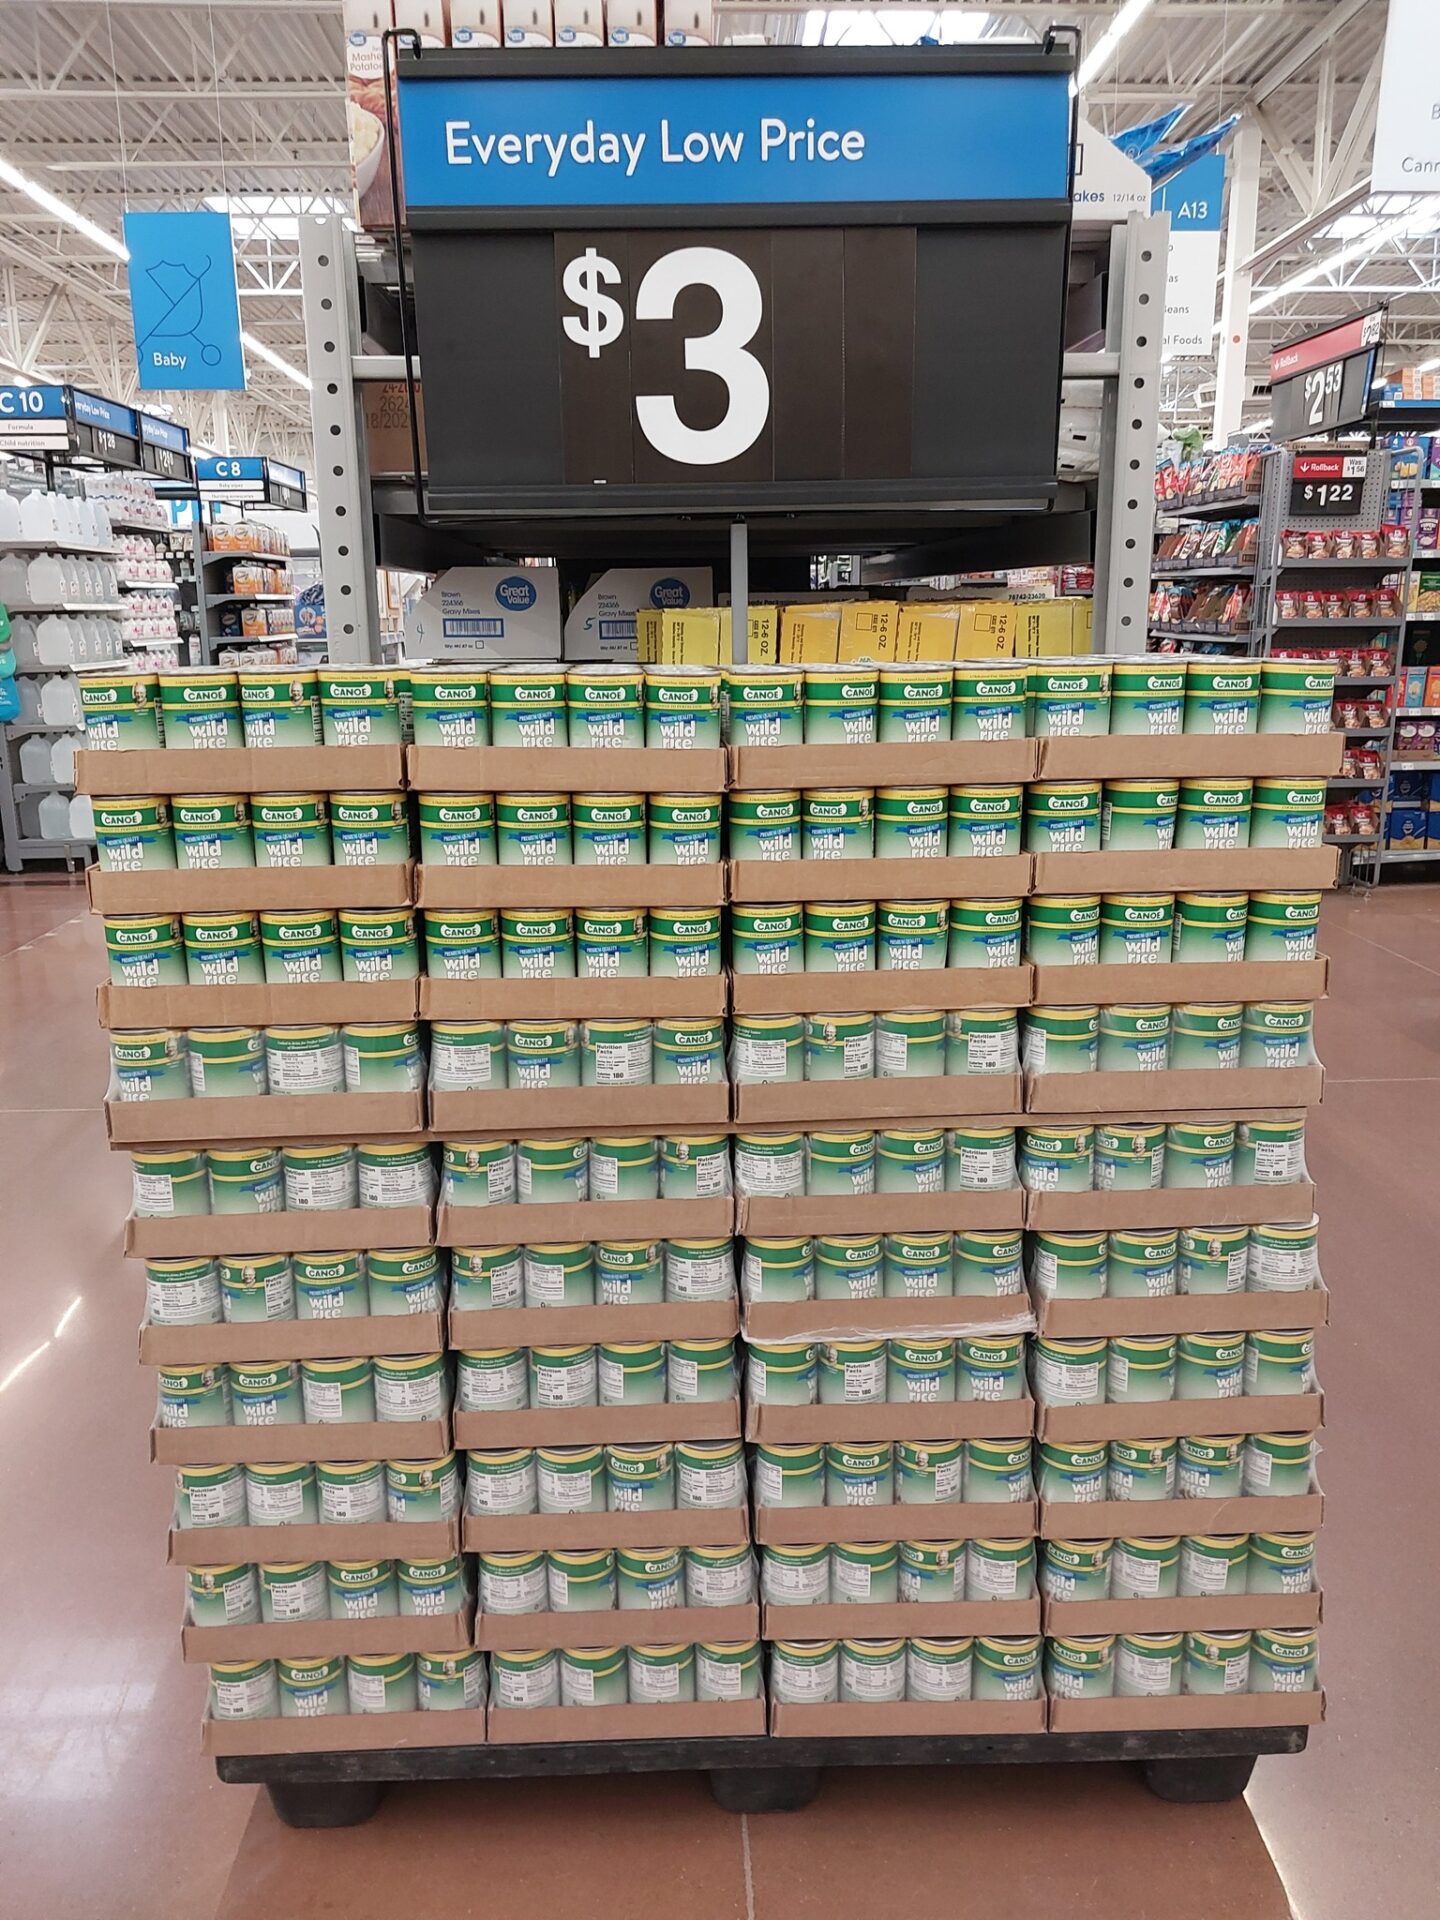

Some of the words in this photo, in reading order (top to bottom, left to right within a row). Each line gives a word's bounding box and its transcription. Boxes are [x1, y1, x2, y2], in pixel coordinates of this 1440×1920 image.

[352, 51, 382, 61] Mashe
[350, 62, 382, 71] Potato
[445, 119, 646, 178] Everyday
[661, 119, 744, 164] Low
[760, 118, 866, 163] Price
[1073, 191, 1105, 202] akes
[1178, 201, 1208, 220] A13
[1173, 335, 1203, 345] Foods
[562, 246, 770, 466] $3
[153, 353, 187, 370] Baby
[1310, 463, 1339, 472] Rollback
[500, 583, 530, 597] Great
[654, 585, 684, 598] Great
[507, 595, 530, 605] Value
[1051, 680, 1085, 690] CANOE
[1151, 679, 1183, 689] CANOE
[1216, 679, 1249, 689] CANOE
[332, 688, 367, 699] CANOE
[845, 688, 875, 698] CANOE
[906, 688, 940, 698] CANOE
[979, 685, 1013, 694] CANOE
[84, 693, 113, 703] CANOE
[187, 691, 224, 701] CANOE
[242, 690, 272, 700] CANOE
[438, 690, 473, 700] CANOE
[517, 690, 552, 700] CANOE
[588, 691, 622, 701] CANOE
[661, 692, 695, 702] CANOE
[746, 691, 779, 700] CANOE
[1048, 707, 1085, 726] wild
[1148, 706, 1179, 724] wild
[1213, 706, 1248, 724] wild
[1304, 704, 1331, 724] wild
[334, 715, 372, 734] wild
[844, 715, 873, 733] wild
[905, 715, 940, 733] wild
[977, 713, 1012, 730] wild
[87, 719, 119, 739] wild
[188, 719, 229, 738] wild
[245, 719, 276, 738] wild
[439, 718, 476, 736] wild
[518, 718, 555, 736] wild
[588, 719, 624, 737] wild
[660, 719, 696, 738] wild
[745, 719, 781, 736] wild
[1051, 800, 1086, 810] CANOE
[1207, 795, 1240, 805] CANOE
[760, 808, 793, 817] CANOE
[811, 806, 843, 815] CANOE
[911, 805, 943, 814] CANOE
[973, 804, 1007, 813] CANOE
[104, 814, 139, 825] CANOE
[184, 812, 217, 822] CANOE
[265, 811, 299, 821] CANOE
[341, 810, 375, 821] CANOE
[443, 811, 477, 821] CANOE
[520, 811, 554, 821] CANOE
[594, 811, 628, 821] CANOE
[675, 812, 708, 821] CANOE
[1128, 911, 1161, 920] CANOE
[445, 927, 478, 936] CANOE
[757, 922, 789, 931] CANOE
[200, 931, 235, 941] CANOE
[1125, 935, 1161, 954] wild
[444, 952, 481, 970] wild
[755, 947, 790, 965] wild
[201, 956, 239, 975] wild
[517, 1038, 549, 1047] CANOE
[517, 1063, 551, 1079] wild
[1029, 1141, 1059, 1151] CANOE
[1027, 1165, 1059, 1182] wild
[905, 1250, 938, 1258] CANOE
[309, 1270, 341, 1279] CANOE
[904, 1273, 938, 1290] wild
[309, 1292, 344, 1309] wild
[906, 1378, 940, 1392] wild
[846, 1459, 876, 1467] CANOE
[844, 1482, 877, 1496] wild
